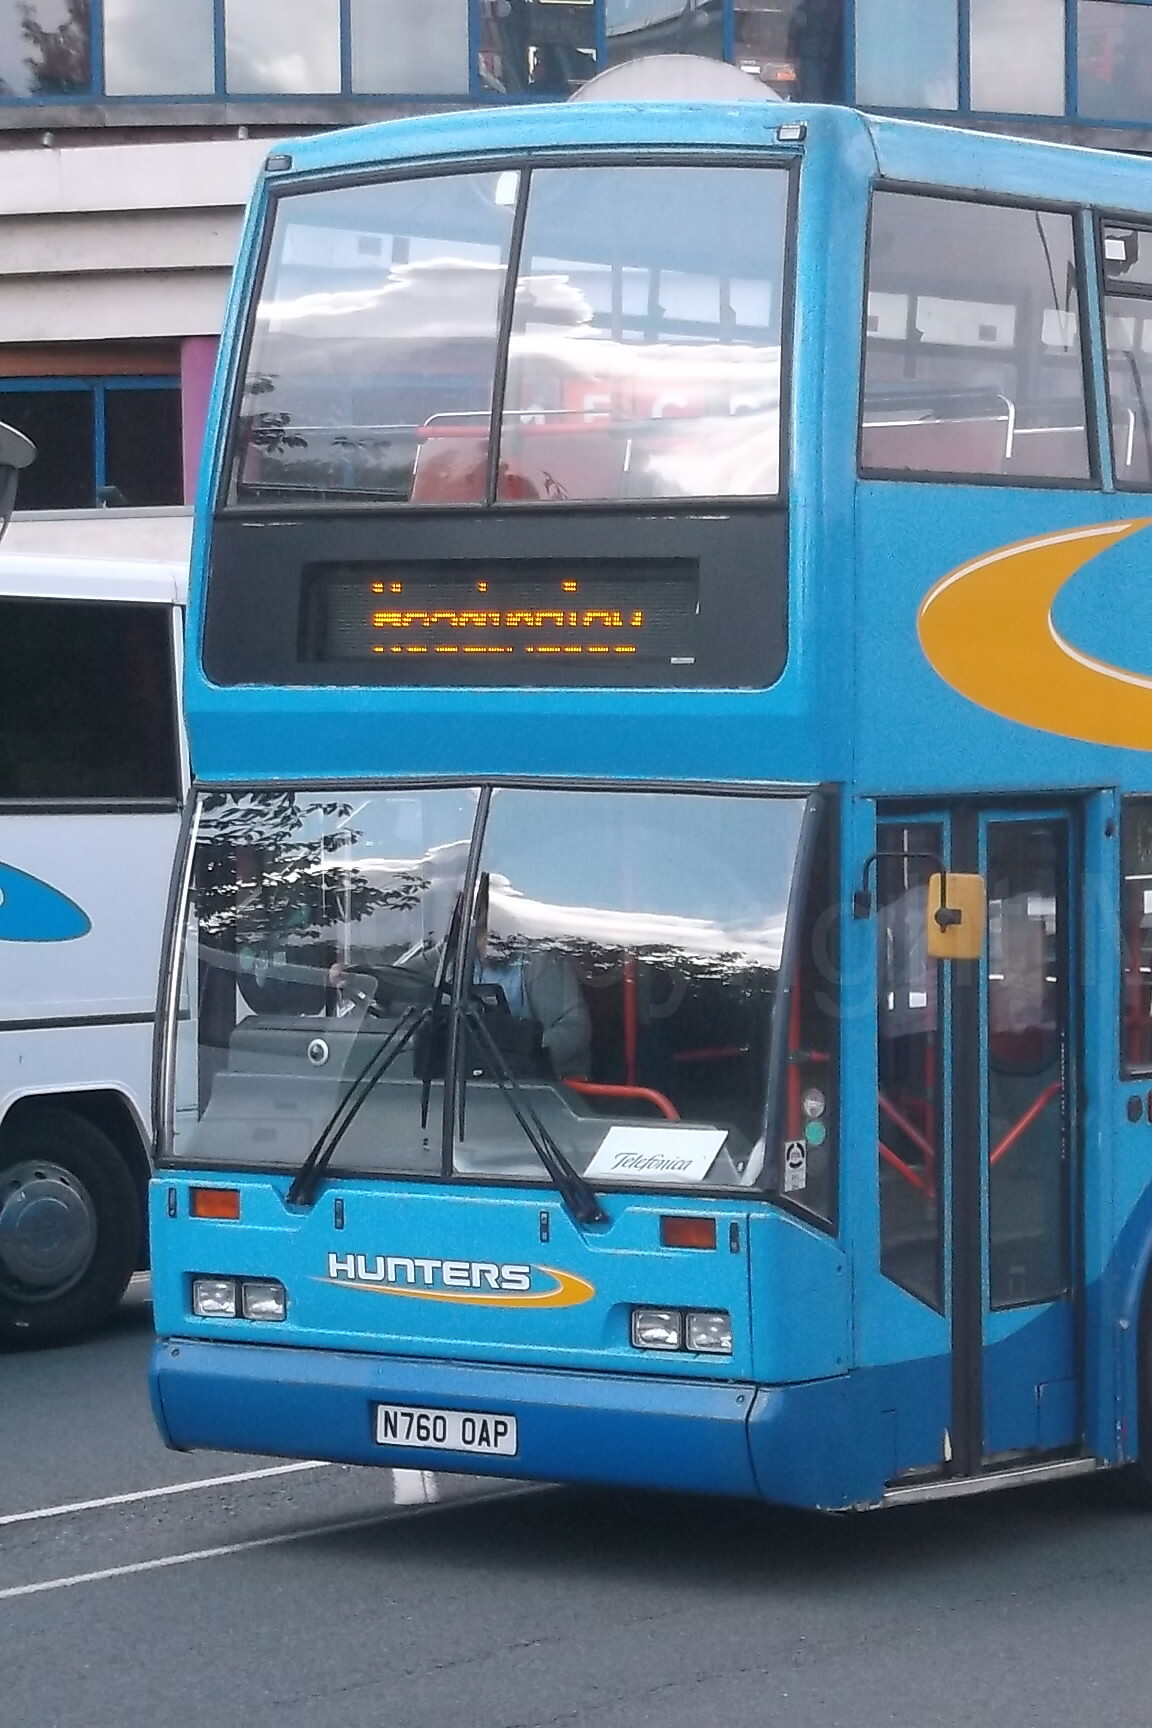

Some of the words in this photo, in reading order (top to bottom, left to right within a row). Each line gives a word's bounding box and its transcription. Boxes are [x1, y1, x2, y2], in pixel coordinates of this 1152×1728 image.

[327, 1252, 531, 1291] HUNTERS
[383, 1410, 447, 1443] N760
[461, 1417, 509, 1448] OAP
